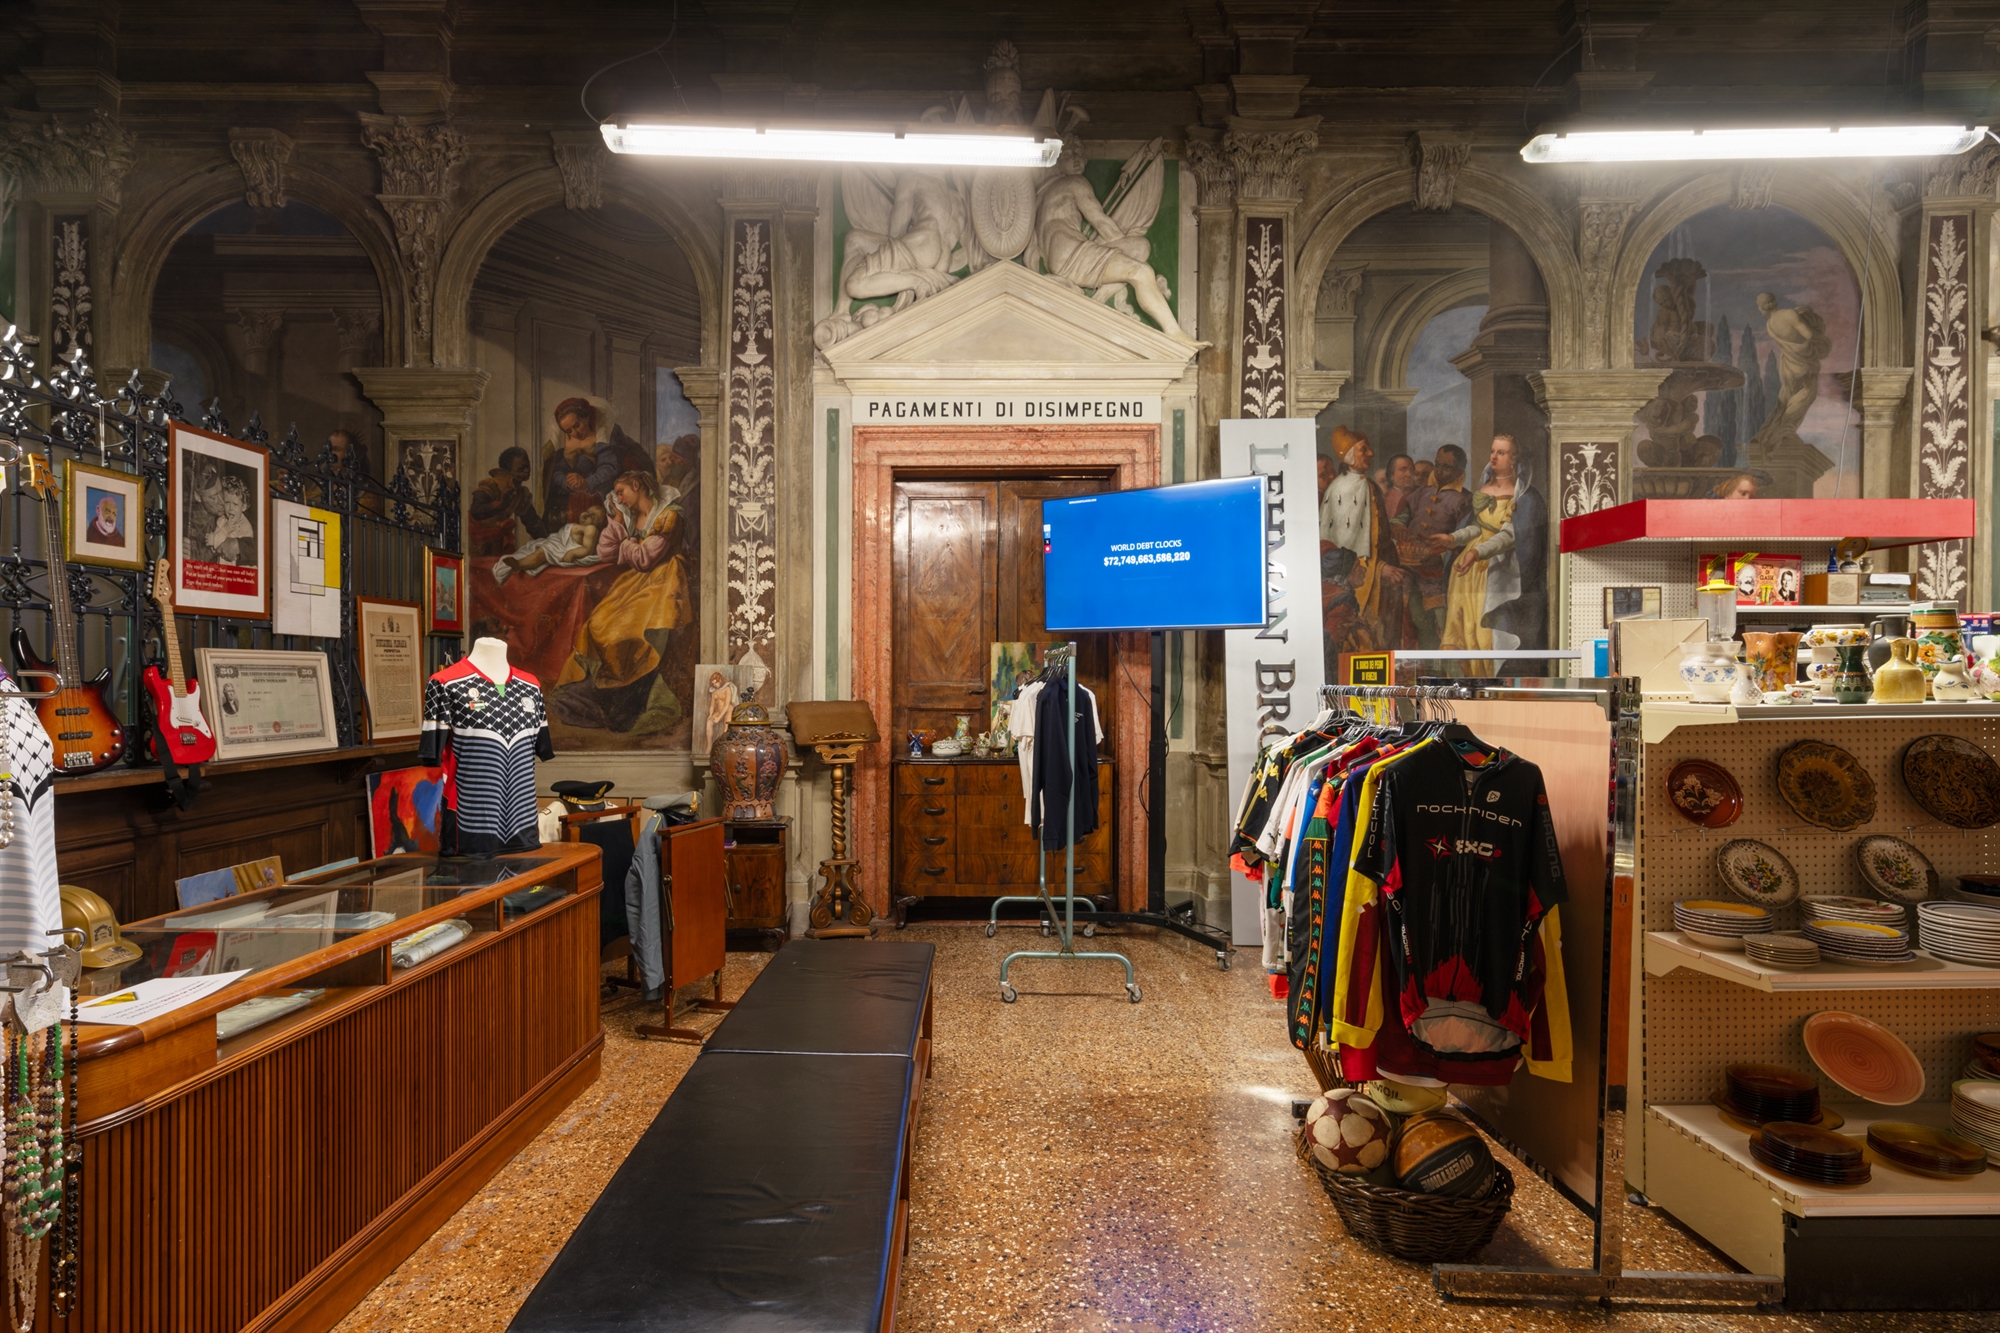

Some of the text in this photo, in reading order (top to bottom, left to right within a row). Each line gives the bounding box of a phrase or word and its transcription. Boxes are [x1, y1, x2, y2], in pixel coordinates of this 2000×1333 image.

[869, 401, 1143, 418] PAGAMENTI DI DISIMPEGNO
[1111, 540, 1182, 552] WORLD DEBT CLOCKS
[220, 667, 234, 675] 50
[1420, 1153, 1475, 1194] OVERTIME
